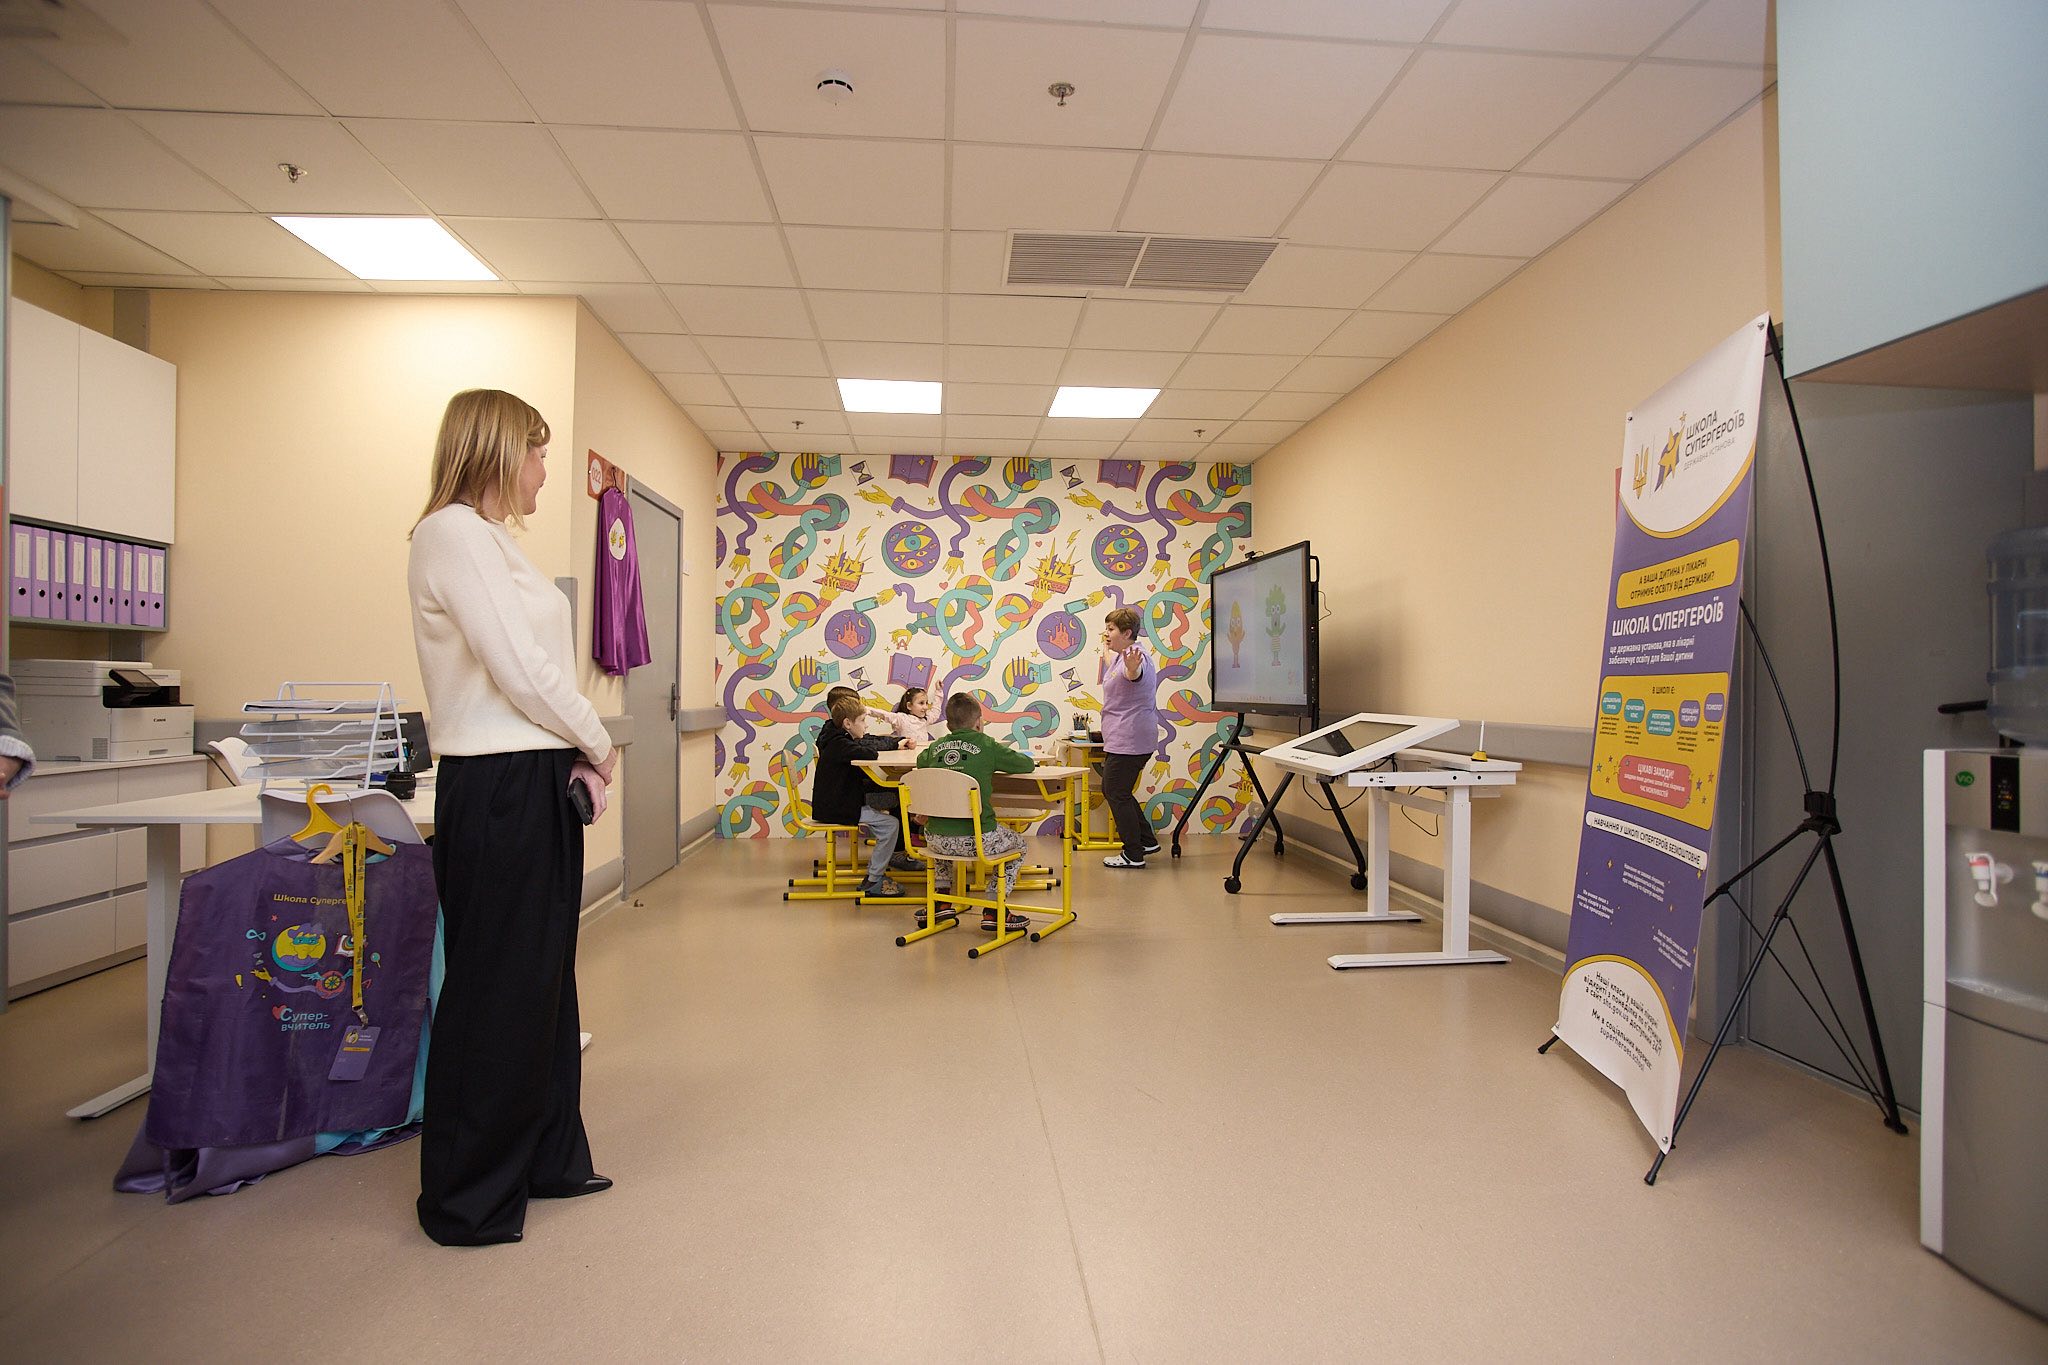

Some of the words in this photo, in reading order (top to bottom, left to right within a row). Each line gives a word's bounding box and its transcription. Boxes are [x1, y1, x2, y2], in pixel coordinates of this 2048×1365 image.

[1685, 410, 1745, 457] СУПЕРГЕРОЇВ
[1686, 410, 1717, 440] ШКОЛА
[1643, 572, 1658, 583] ВАША
[1658, 566, 1680, 582] ДИТИНА
[1685, 558, 1707, 573] ЛІКАРНІ
[1630, 585, 1654, 600] ОТРИМУЄ
[1655, 582, 1673, 595] ОСВІТУ
[1674, 580, 1683, 592] ВІД
[1684, 571, 1715, 589] ДЕРЖАВИ?
[1612, 616, 1650, 637] ШКОЛА
[1652, 596, 1724, 632] СУПЕРГЕРОЇВ
[1609, 646, 1617, 654] це
[1617, 642, 1640, 654] державна
[1676, 636, 1695, 647] лікарні
[1609, 654, 1636, 666] забезпечує
[1636, 653, 1650, 664] освіту
[1650, 653, 1659, 664] для
[1675, 651, 1694, 661] дитини
[1656, 686, 1670, 694] ШКОЛІ
[1594, 817, 1619, 830] НАВЧАННЯ
[1624, 827, 1639, 838] ШКОЛІ
[1640, 832, 1668, 850] СУПЕРГЕРОЇВ
[1668, 842, 1700, 864] БЕЗКОШТОВНЕ
[273, 893, 307, 904] Школа
[1584, 975, 1607, 995] відкриті
[1612, 994, 1638, 1019] понеділка
[1638, 1015, 1644, 1025] по
[1596, 971, 1610, 986] Наші
[1610, 984, 1625, 998] класи
[1626, 994, 1630, 1003] у
[1630, 998, 1644, 1012] вашій
[281, 1008, 329, 1022] Супер-
[281, 1022, 331, 1032] вчитель
[1590, 989, 1602, 1002] сайт
[1630, 1019, 1652, 1045] доступний
[1592, 1008, 1600, 1021] Ми
[1606, 1021, 1634, 1049] соціальних
